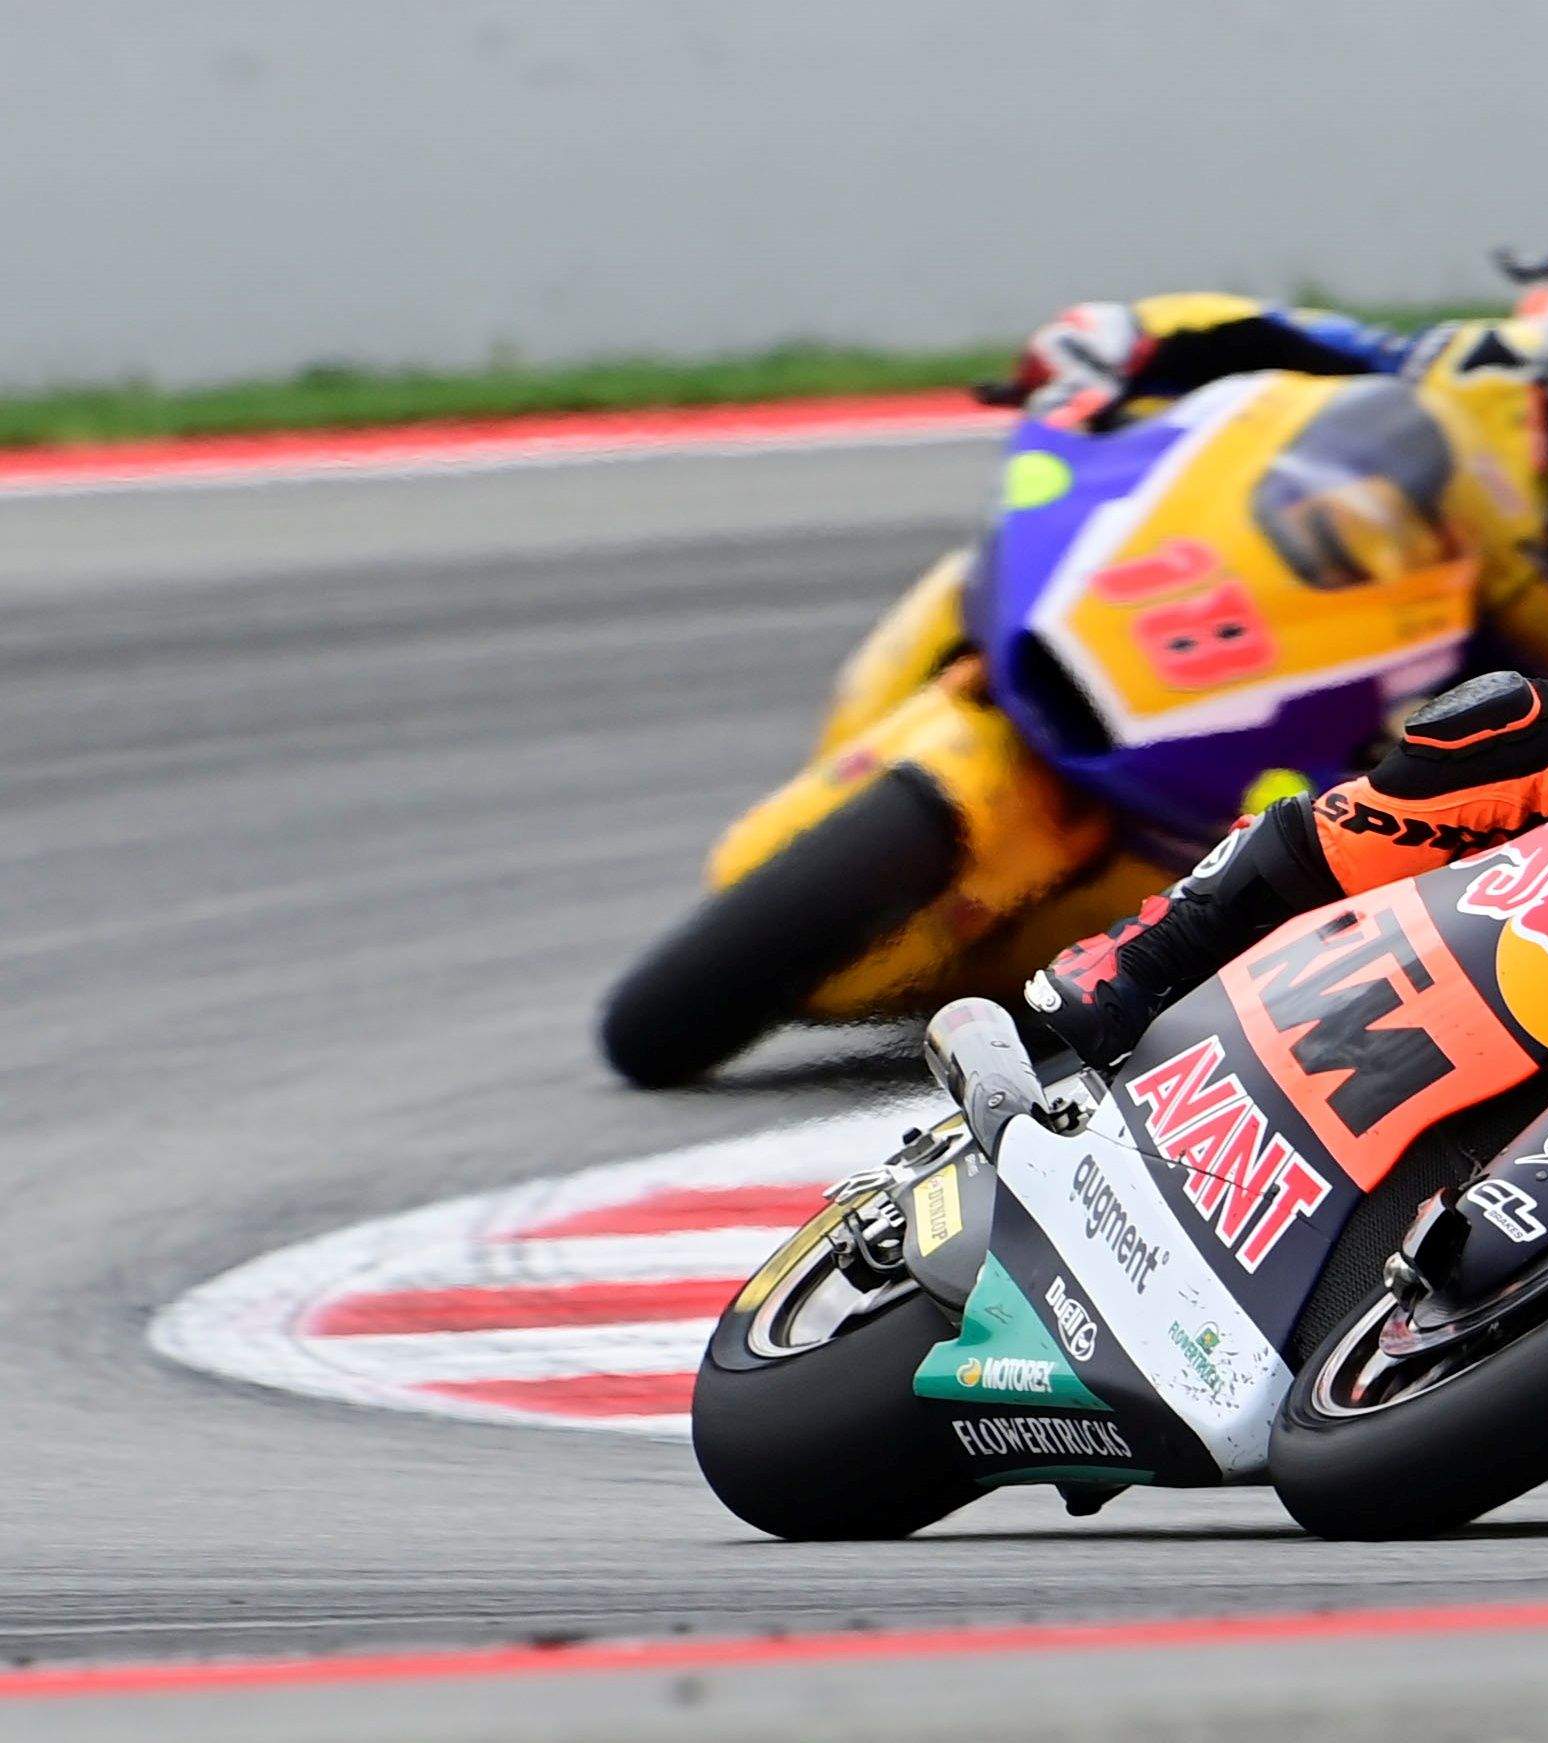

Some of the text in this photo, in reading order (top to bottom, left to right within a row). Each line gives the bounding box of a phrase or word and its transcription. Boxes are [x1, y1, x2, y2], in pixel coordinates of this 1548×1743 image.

[1088, 538, 1280, 689] 18
[1246, 907, 1457, 1139] KTM
[1125, 1034, 1334, 1275] AVANT
[927, 1187, 949, 1241] DUNLOP
[982, 1357, 1057, 1393] MOTOREX
[952, 1417, 1133, 1459] FLOWERTRUCKS
